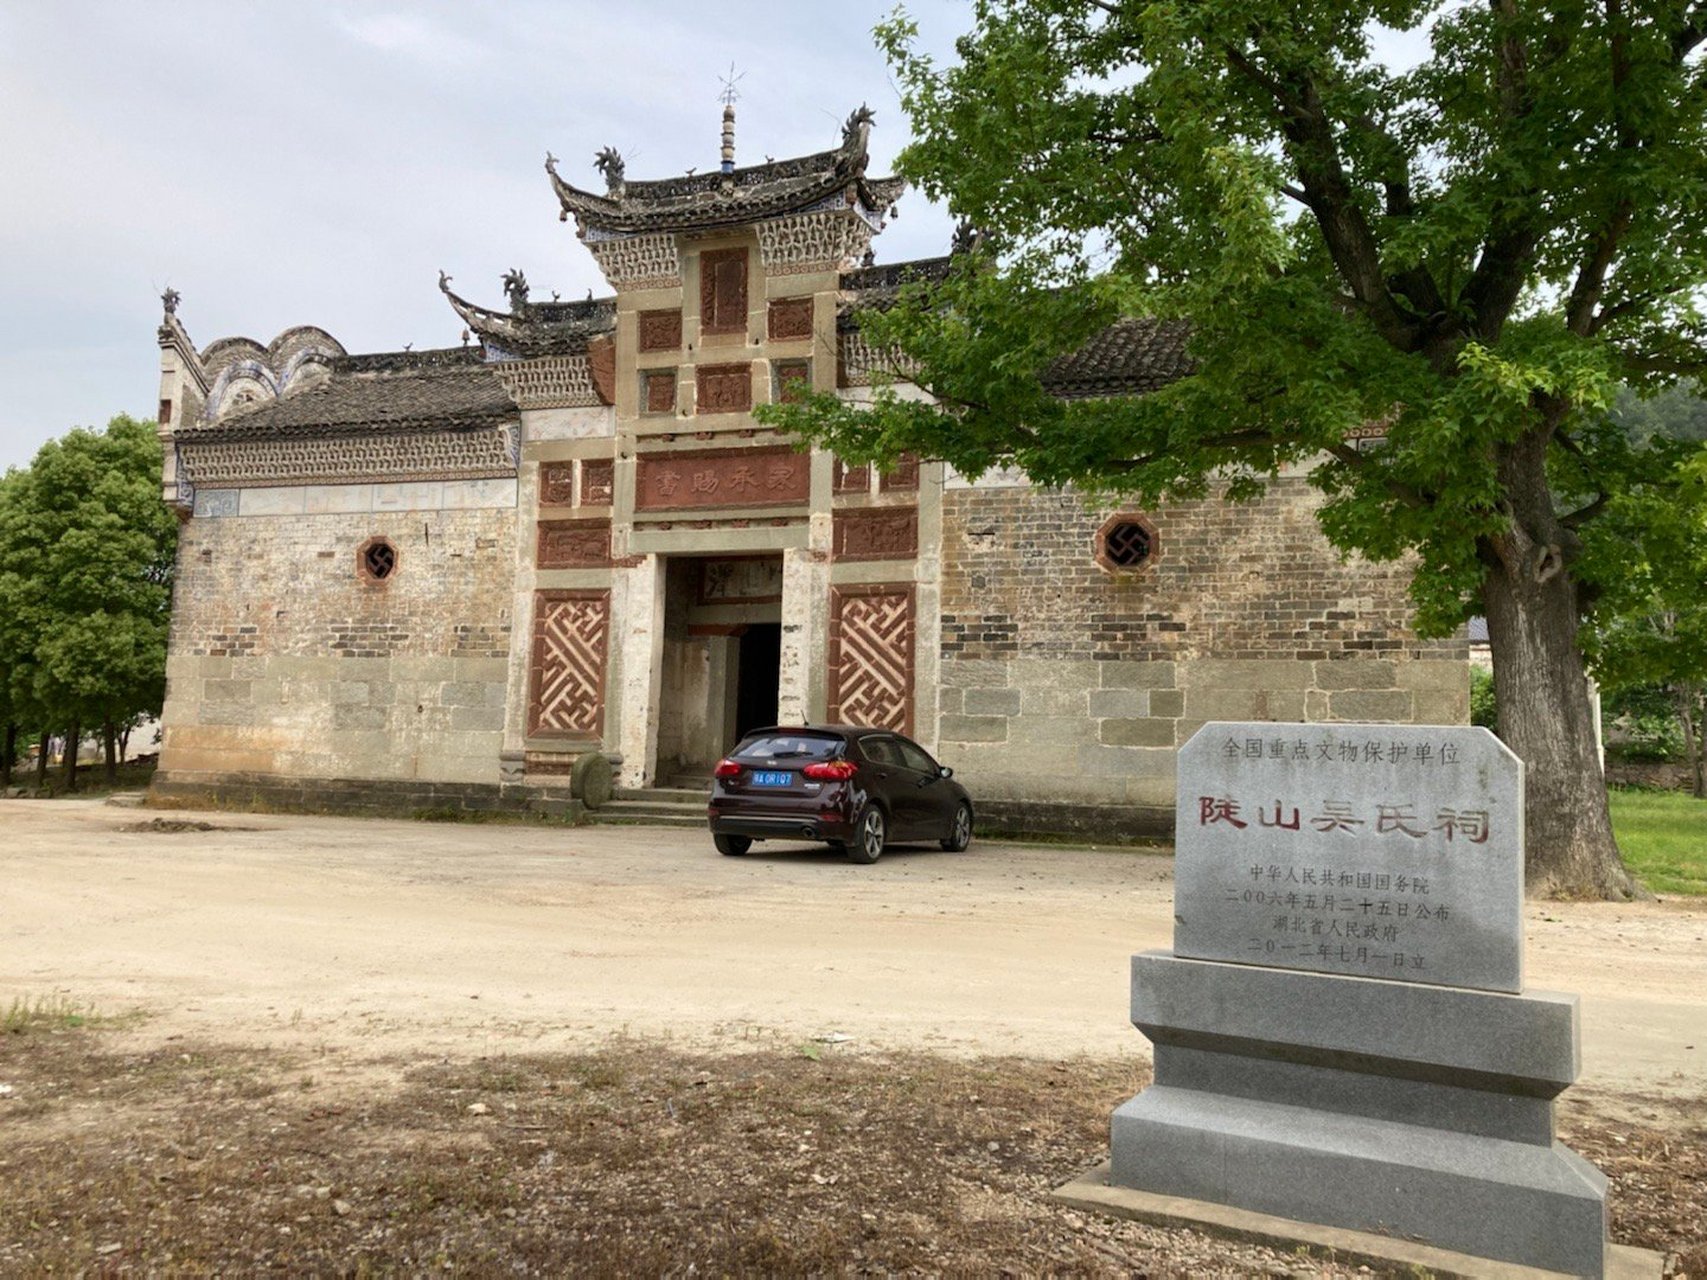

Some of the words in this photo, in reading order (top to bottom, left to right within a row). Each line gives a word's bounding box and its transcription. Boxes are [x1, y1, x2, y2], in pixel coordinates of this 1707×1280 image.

[1222, 737, 1461, 766] 全国重点文物保护单位
[1199, 796, 1490, 844] 陡山吴氏祠
[1249, 864, 1430, 895] 中华人民共和国国务院
[1272, 915, 1400, 943] 湖北省人民政府
